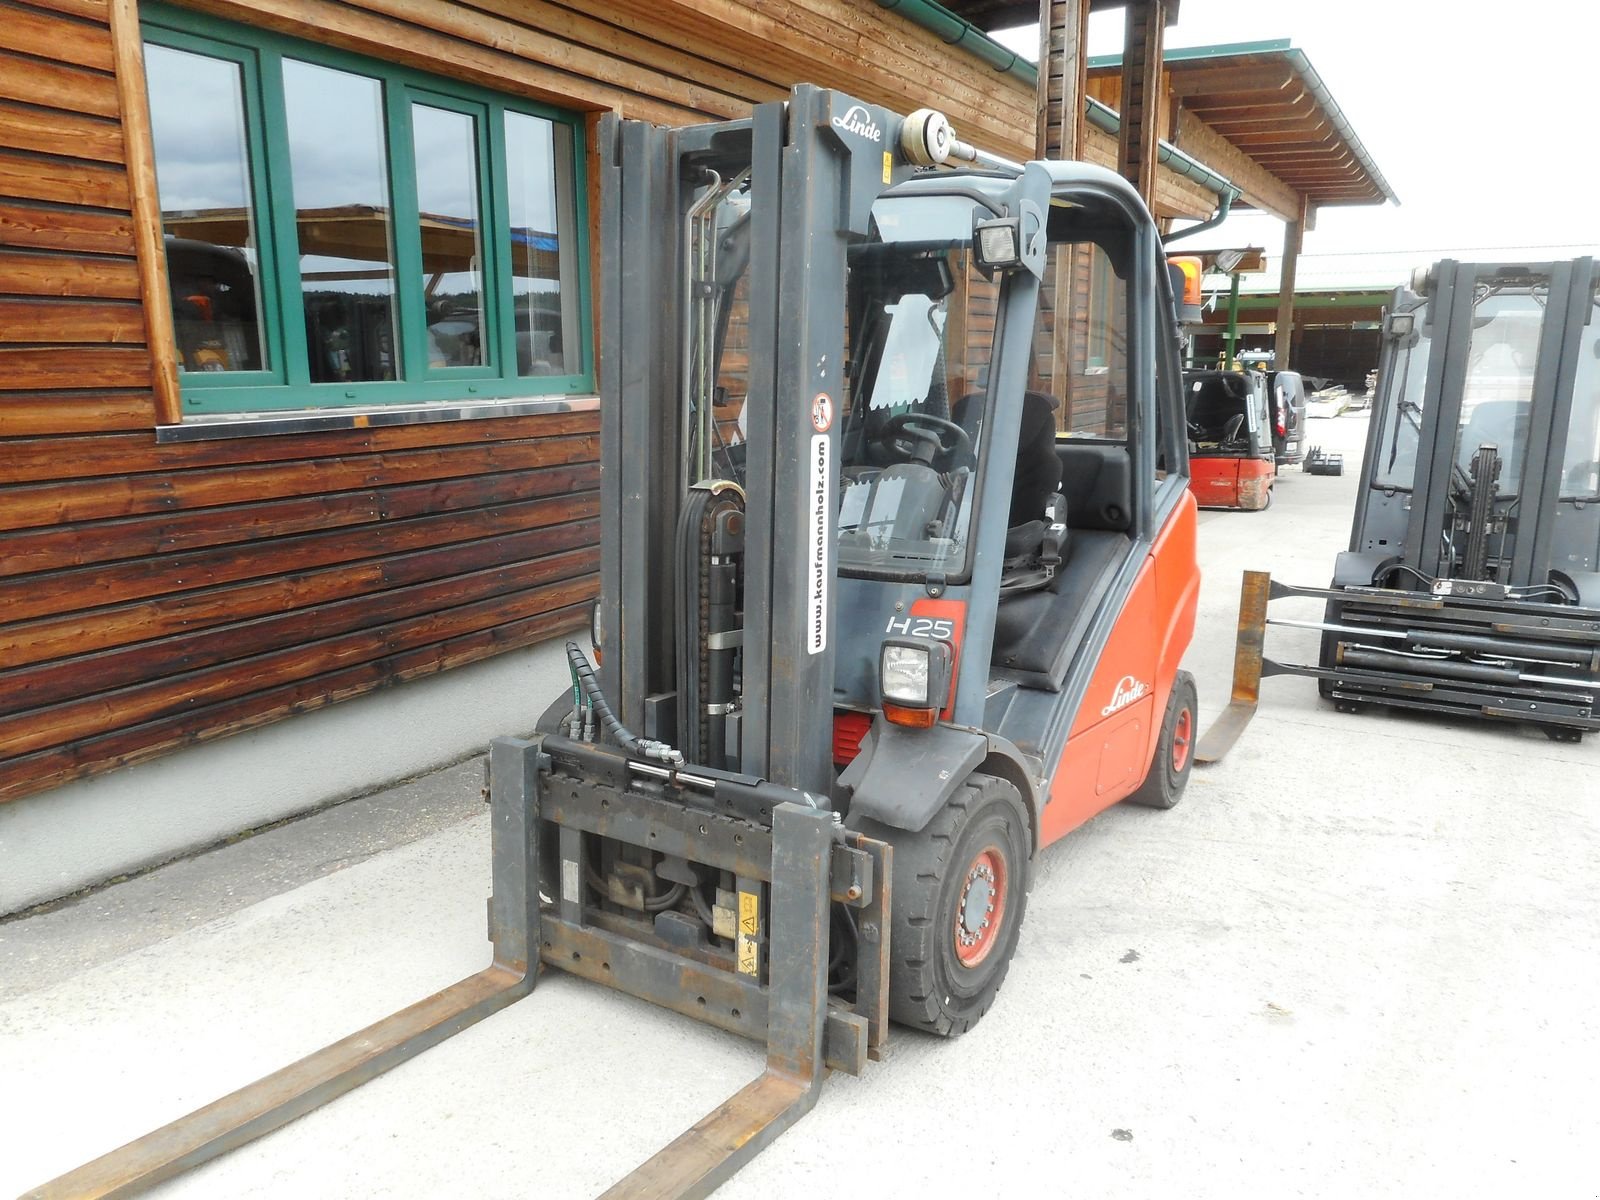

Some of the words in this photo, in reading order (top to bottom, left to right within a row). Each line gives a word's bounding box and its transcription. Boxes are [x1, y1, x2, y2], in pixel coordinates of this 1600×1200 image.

[832, 105, 881, 142] Linde
[814, 441, 825, 648] www.kaufmannholz.com
[1101, 675, 1144, 716] Linde
